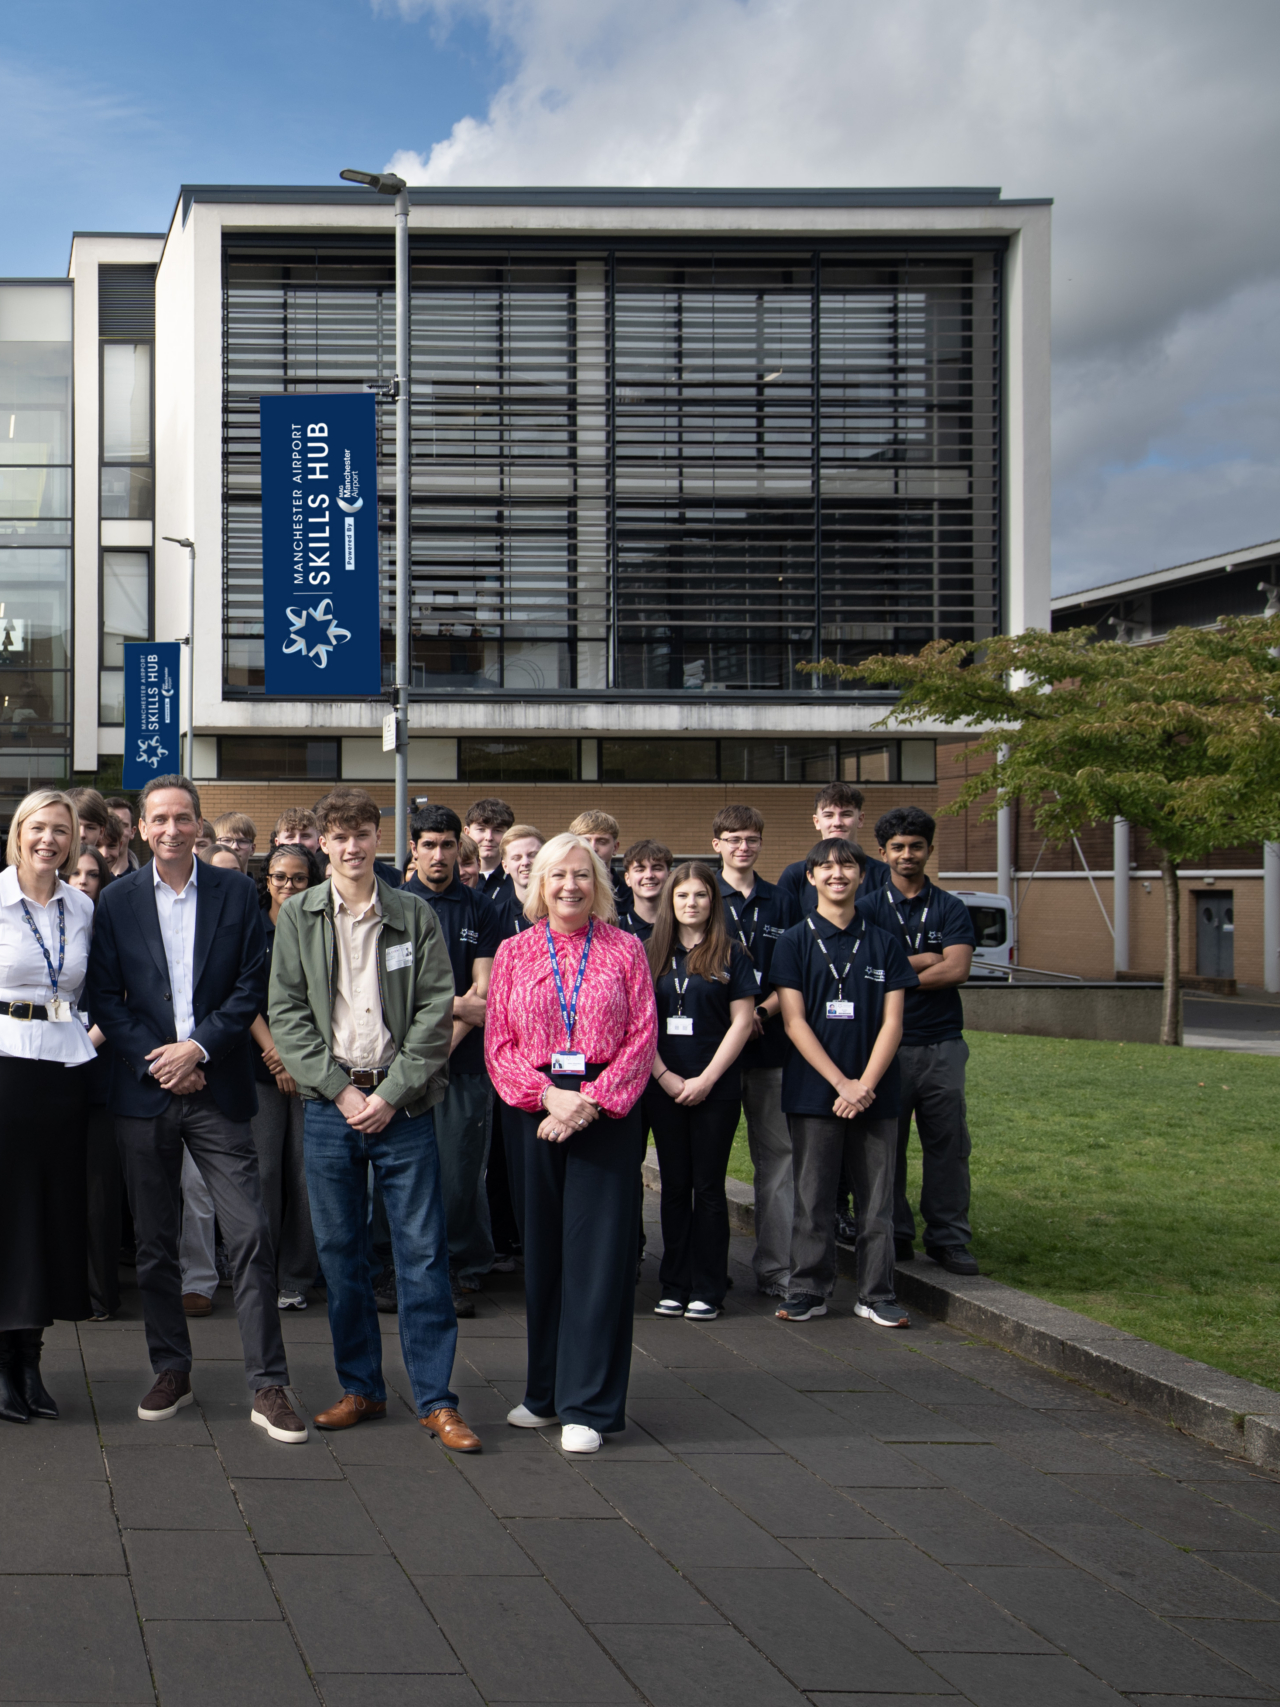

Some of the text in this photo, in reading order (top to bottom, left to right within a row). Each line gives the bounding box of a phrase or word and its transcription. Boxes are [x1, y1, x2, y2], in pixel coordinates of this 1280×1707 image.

[291, 423, 304, 584] MANCHESTER AIRPORT
[307, 422, 331, 586] SKILLS HUB
[343, 448, 352, 498] Manchester
[351, 470, 360, 498] Airport
[346, 523, 354, 566] Powered By
[147, 654, 159, 730] SKILLS HUB
